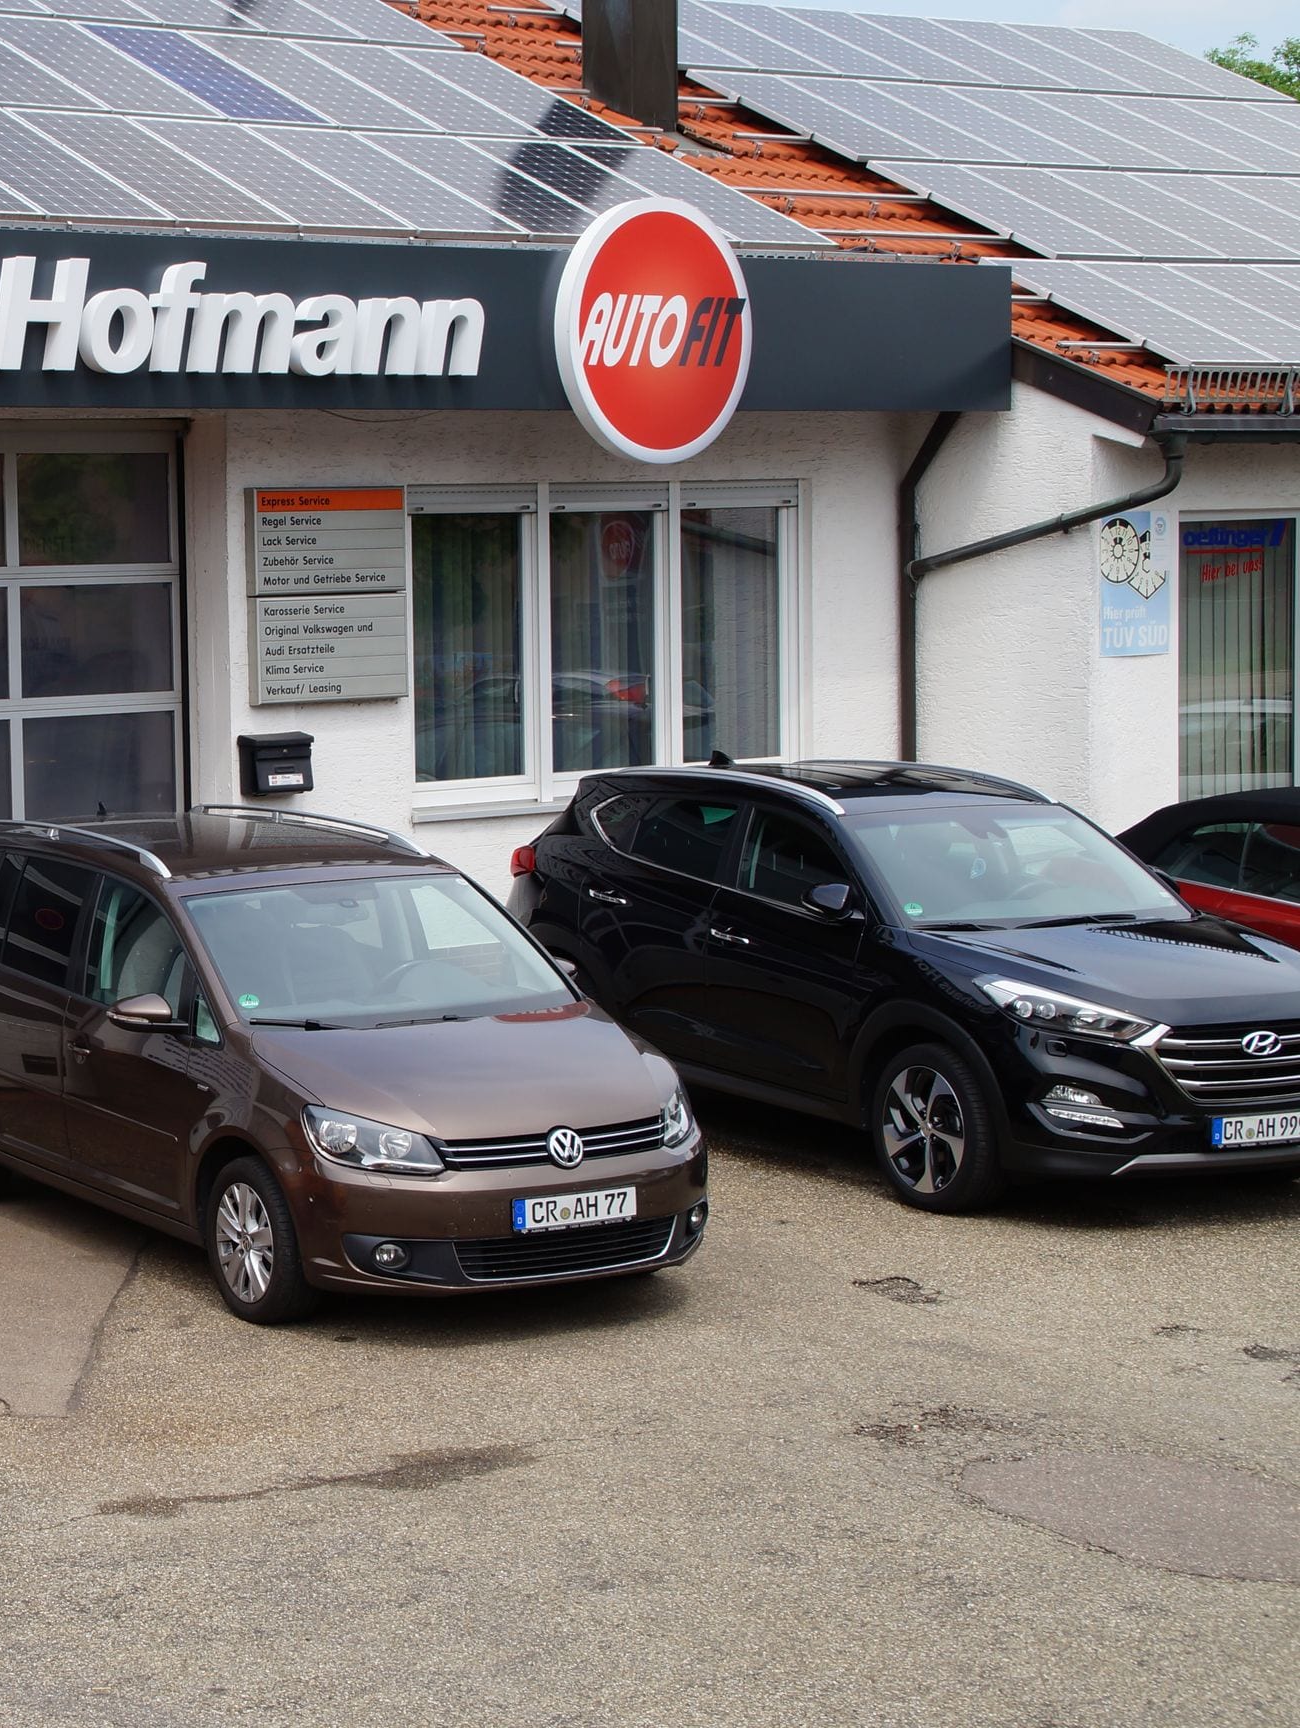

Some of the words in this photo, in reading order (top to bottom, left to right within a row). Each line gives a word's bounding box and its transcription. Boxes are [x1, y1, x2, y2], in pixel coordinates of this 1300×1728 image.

[261, 497, 295, 508] Express
[299, 496, 330, 506] Service
[262, 517, 287, 528] Regel
[290, 516, 322, 526] Service
[262, 536, 282, 546] Lack
[286, 536, 317, 546] Service
[263, 556, 299, 567] Zubehör
[303, 555, 334, 565] Service
[263, 576, 290, 586] Motor
[294, 575, 310, 585] und
[313, 573, 351, 584] Getriebe
[355, 572, 386, 582] Service
[264, 606, 310, 617] Karosserie
[314, 605, 345, 615] Service
[264, 625, 299, 637] Original
[302, 623, 354, 636] Volkswagen
[357, 622, 373, 632] und
[1103, 621, 1135, 648] TÜV
[1138, 620, 1167, 647] SÜD
[265, 646, 285, 656] Audi
[288, 644, 335, 655] Ersatzteile
[265, 665, 290, 675] Klima
[293, 664, 325, 674] Service
[266, 684, 305, 695] Verkauf/
[308, 682, 342, 694] Leasing
[1224, 1120, 1243, 1140] CR
[1256, 1117, 1276, 1138] AH
[1280, 1115, 1300, 1136] 99
[532, 1200, 558, 1224] CR
[574, 1195, 598, 1219] AH
[605, 1191, 627, 1215] 77
